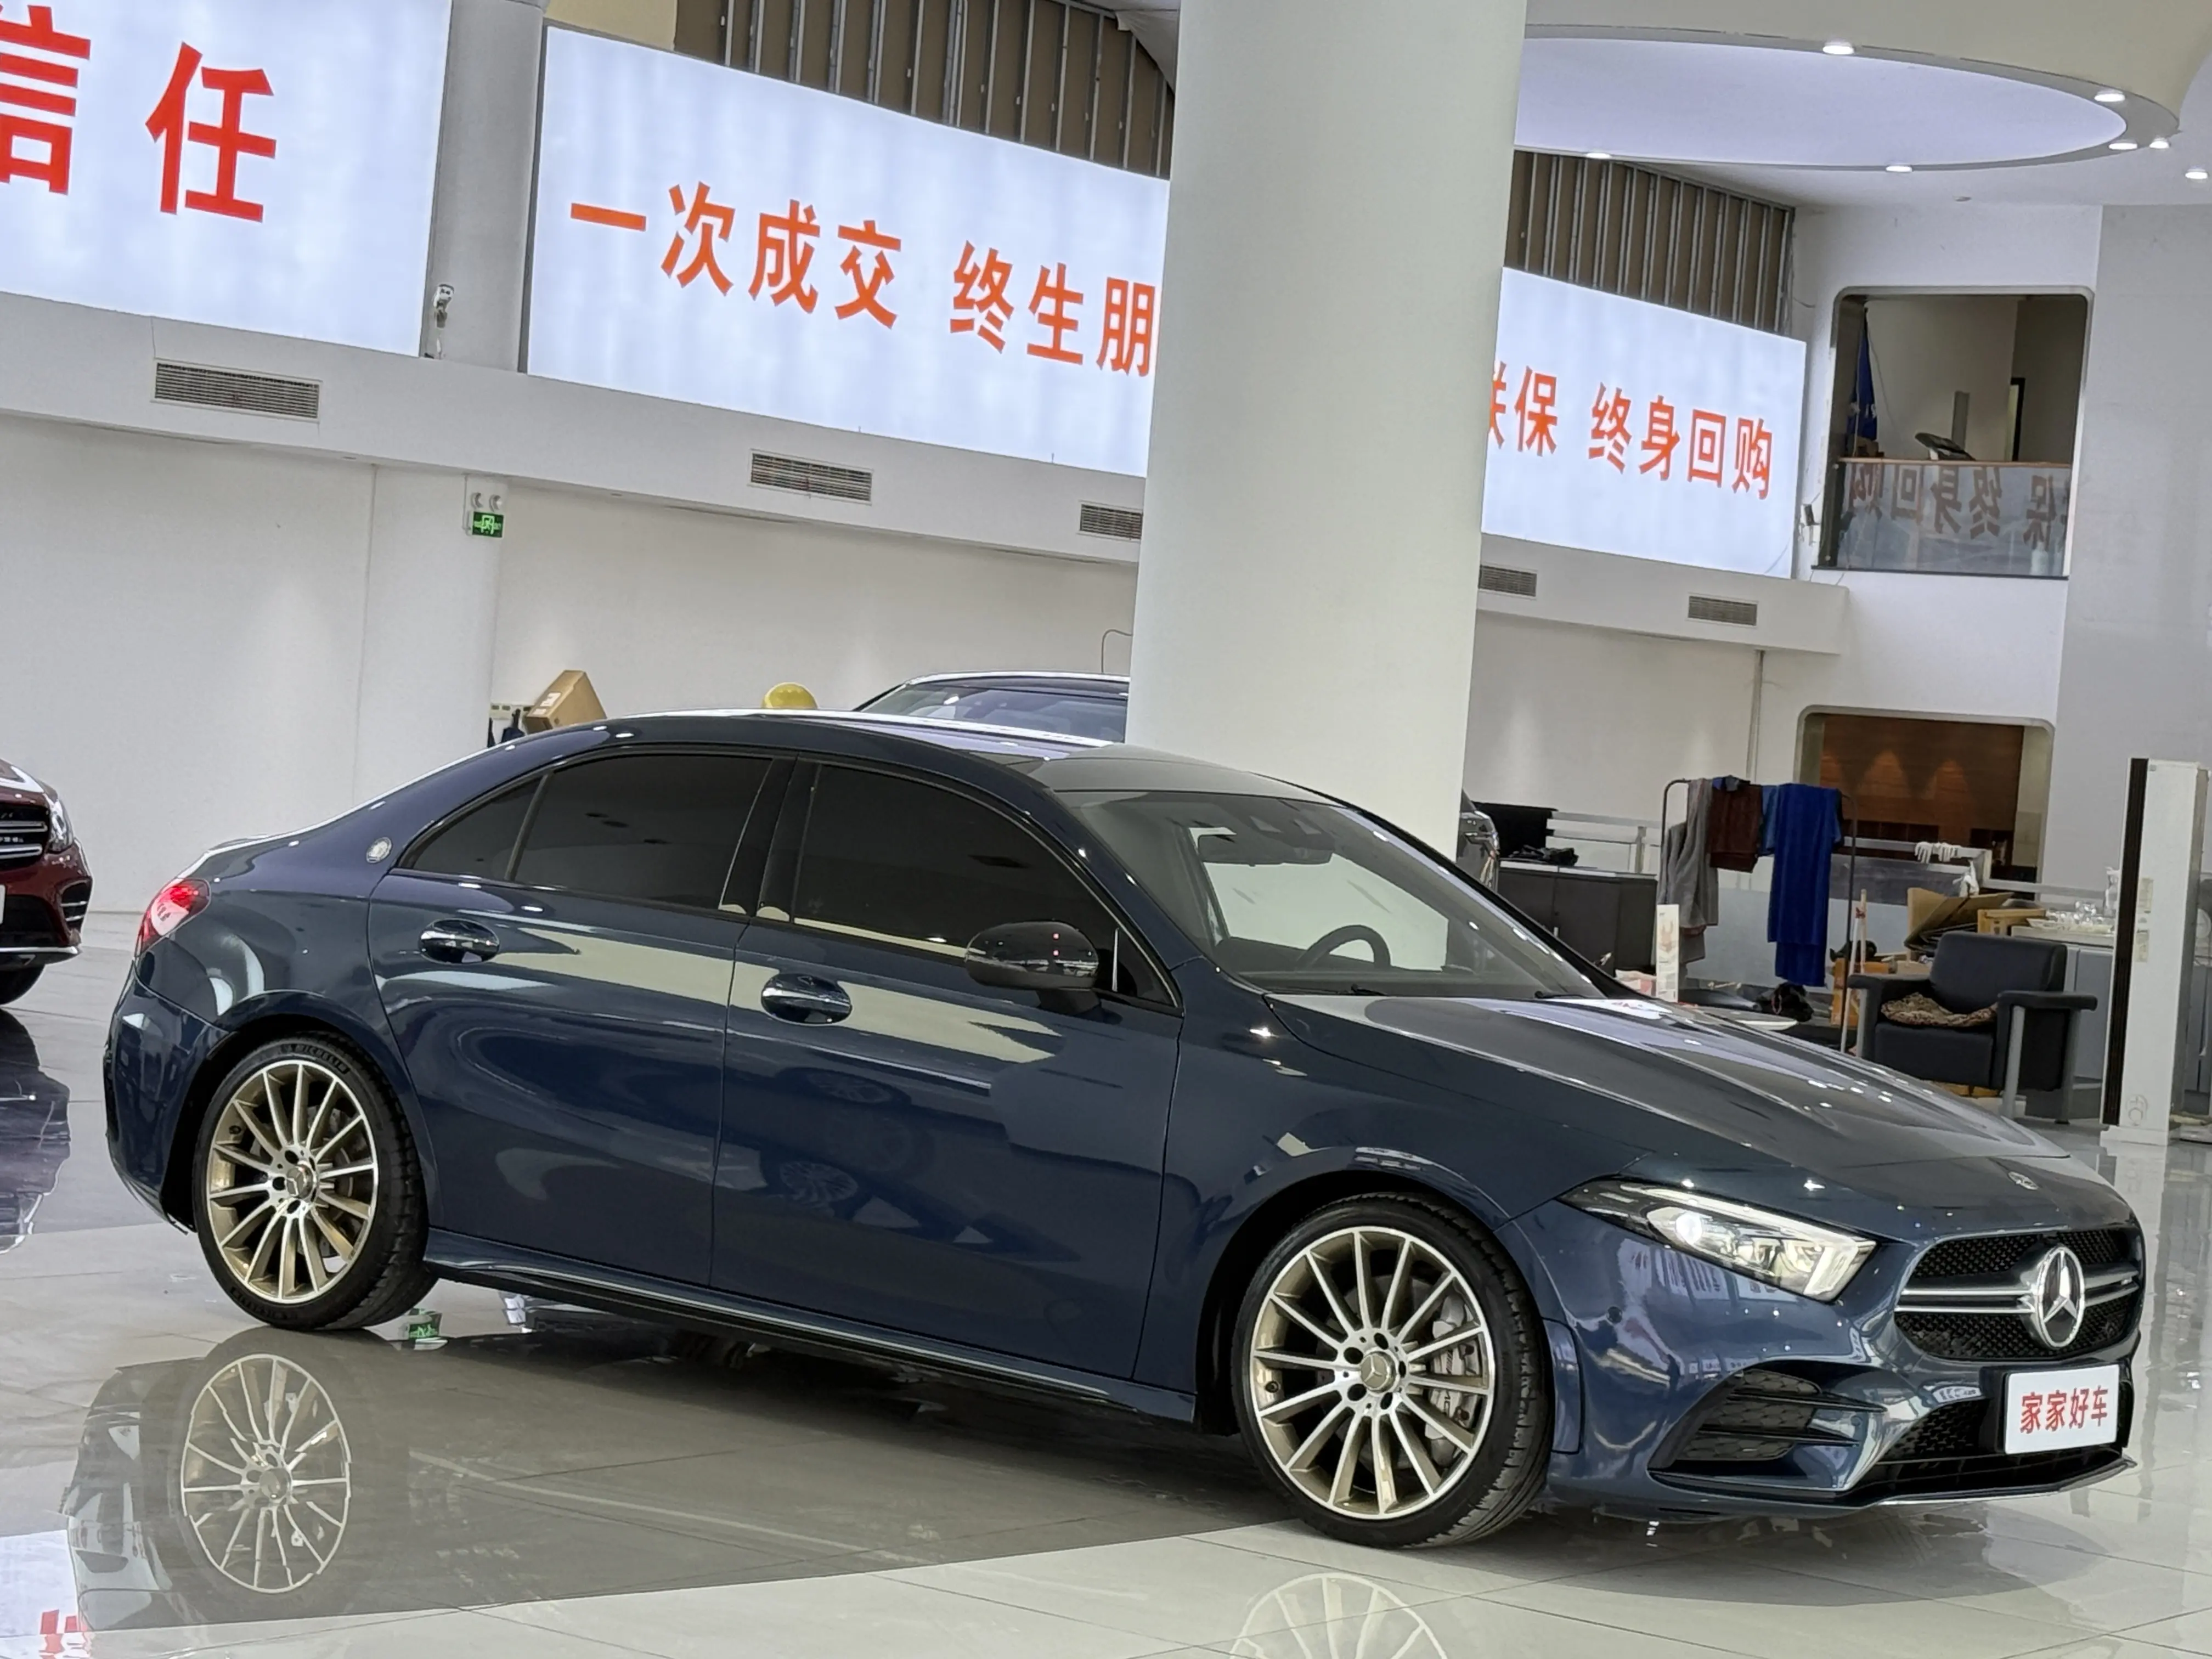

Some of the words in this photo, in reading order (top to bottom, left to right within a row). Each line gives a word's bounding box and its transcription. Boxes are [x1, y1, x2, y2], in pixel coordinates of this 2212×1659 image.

[0, 4, 276, 223] 信任
[570, 182, 901, 329] 一次成交
[950, 240, 1155, 377] 终生朋
[1588, 382, 1773, 500] 终身回购
[2020, 1385, 2108, 1434] 家家好车
